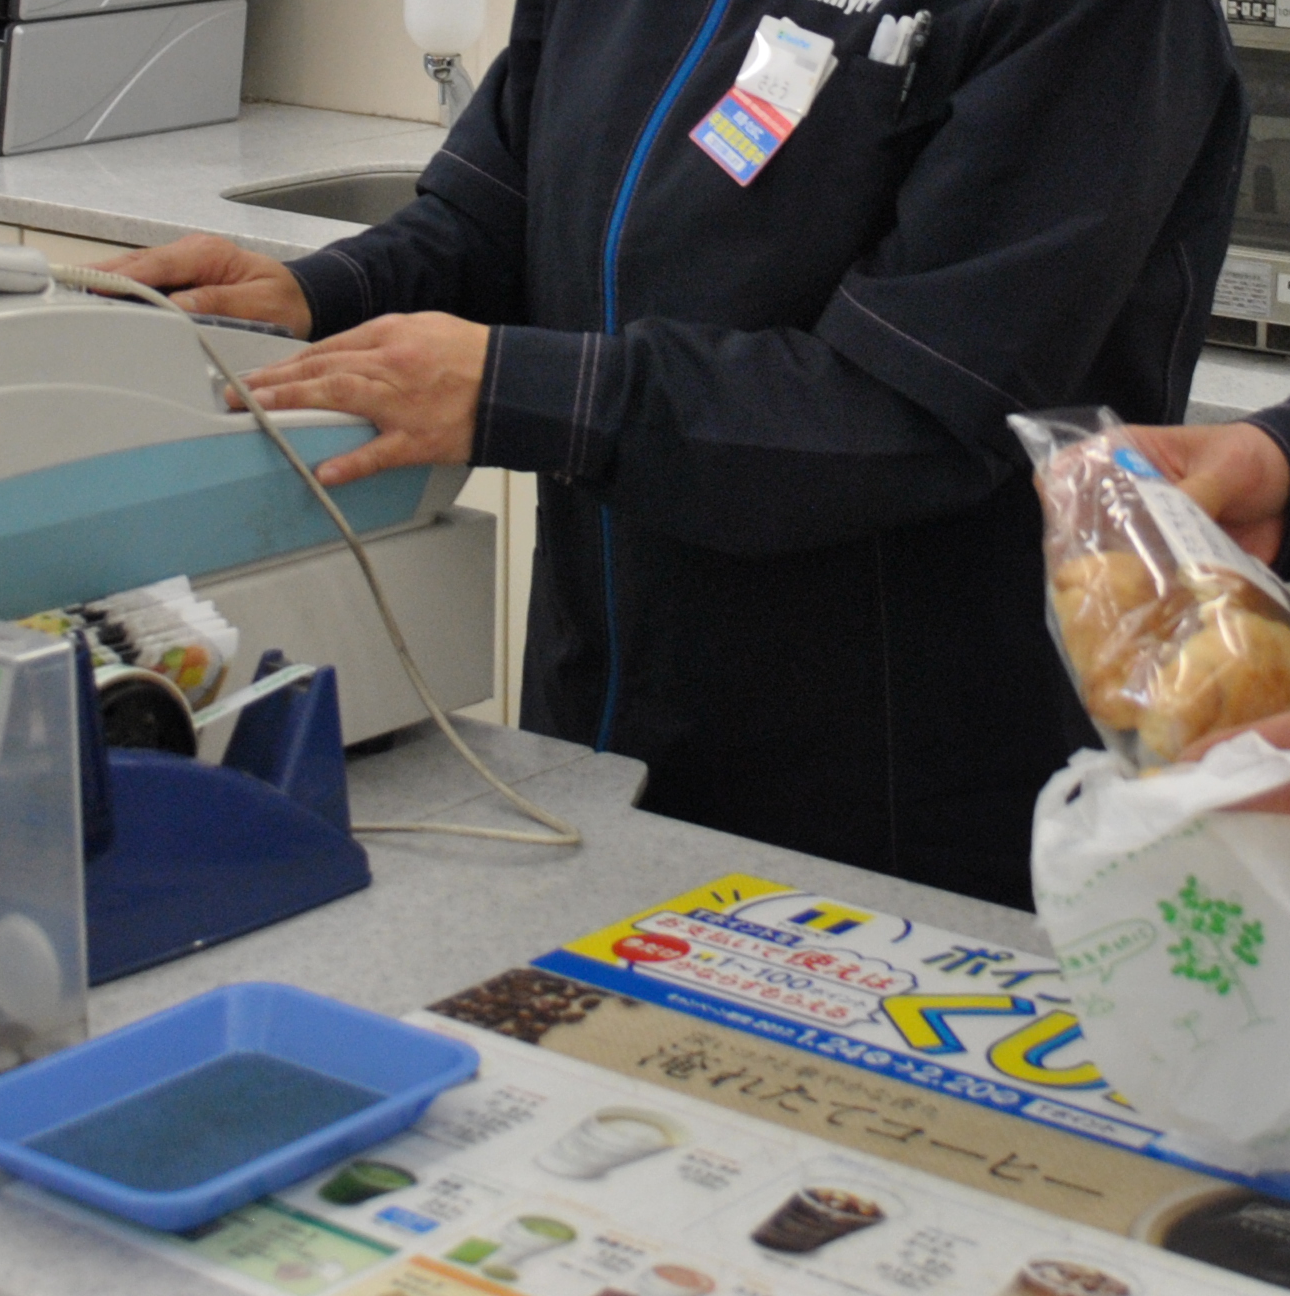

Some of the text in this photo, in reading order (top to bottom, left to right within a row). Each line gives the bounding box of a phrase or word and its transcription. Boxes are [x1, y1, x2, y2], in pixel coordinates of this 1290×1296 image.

[655, 912, 898, 995] お支払いで使えば
[672, 957, 850, 1022] かならずもらえる
[637, 1042, 1106, 1199] 淹れたてコーヒー
